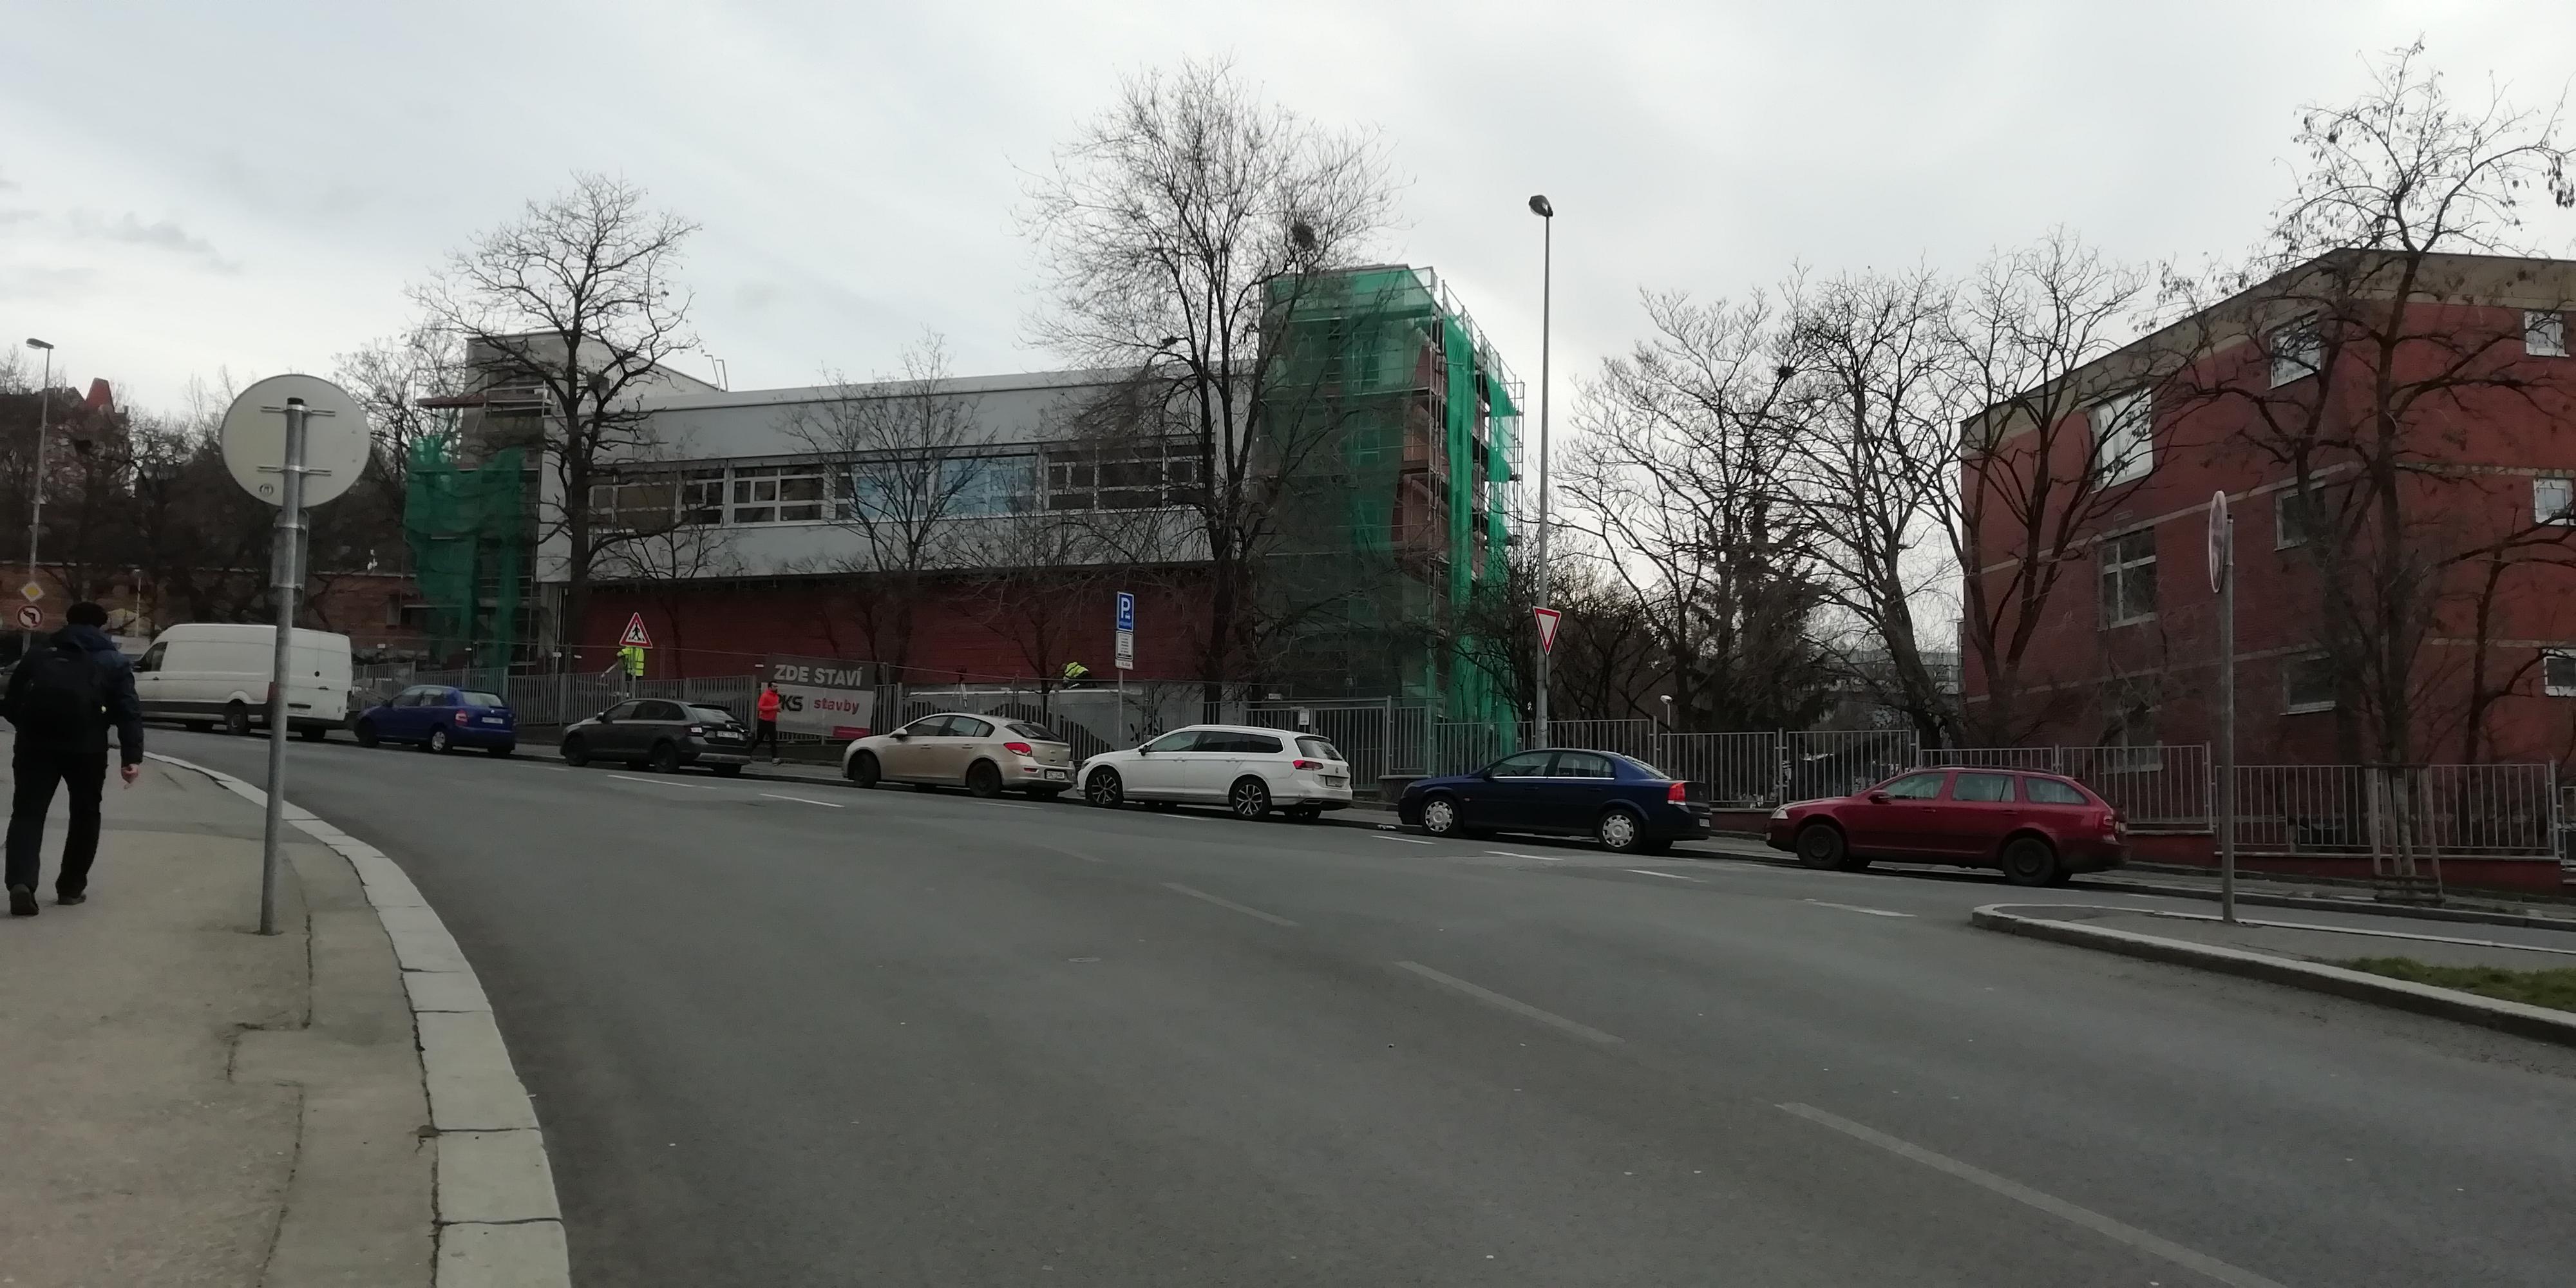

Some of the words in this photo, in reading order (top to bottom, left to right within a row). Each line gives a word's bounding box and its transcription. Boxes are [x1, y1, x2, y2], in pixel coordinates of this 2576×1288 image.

[1121, 597, 1131, 619] P
[774, 664, 809, 682] ZDE
[814, 667, 862, 686] STAVÍ
[777, 694, 803, 712] KS
[813, 697, 860, 715] stavby
